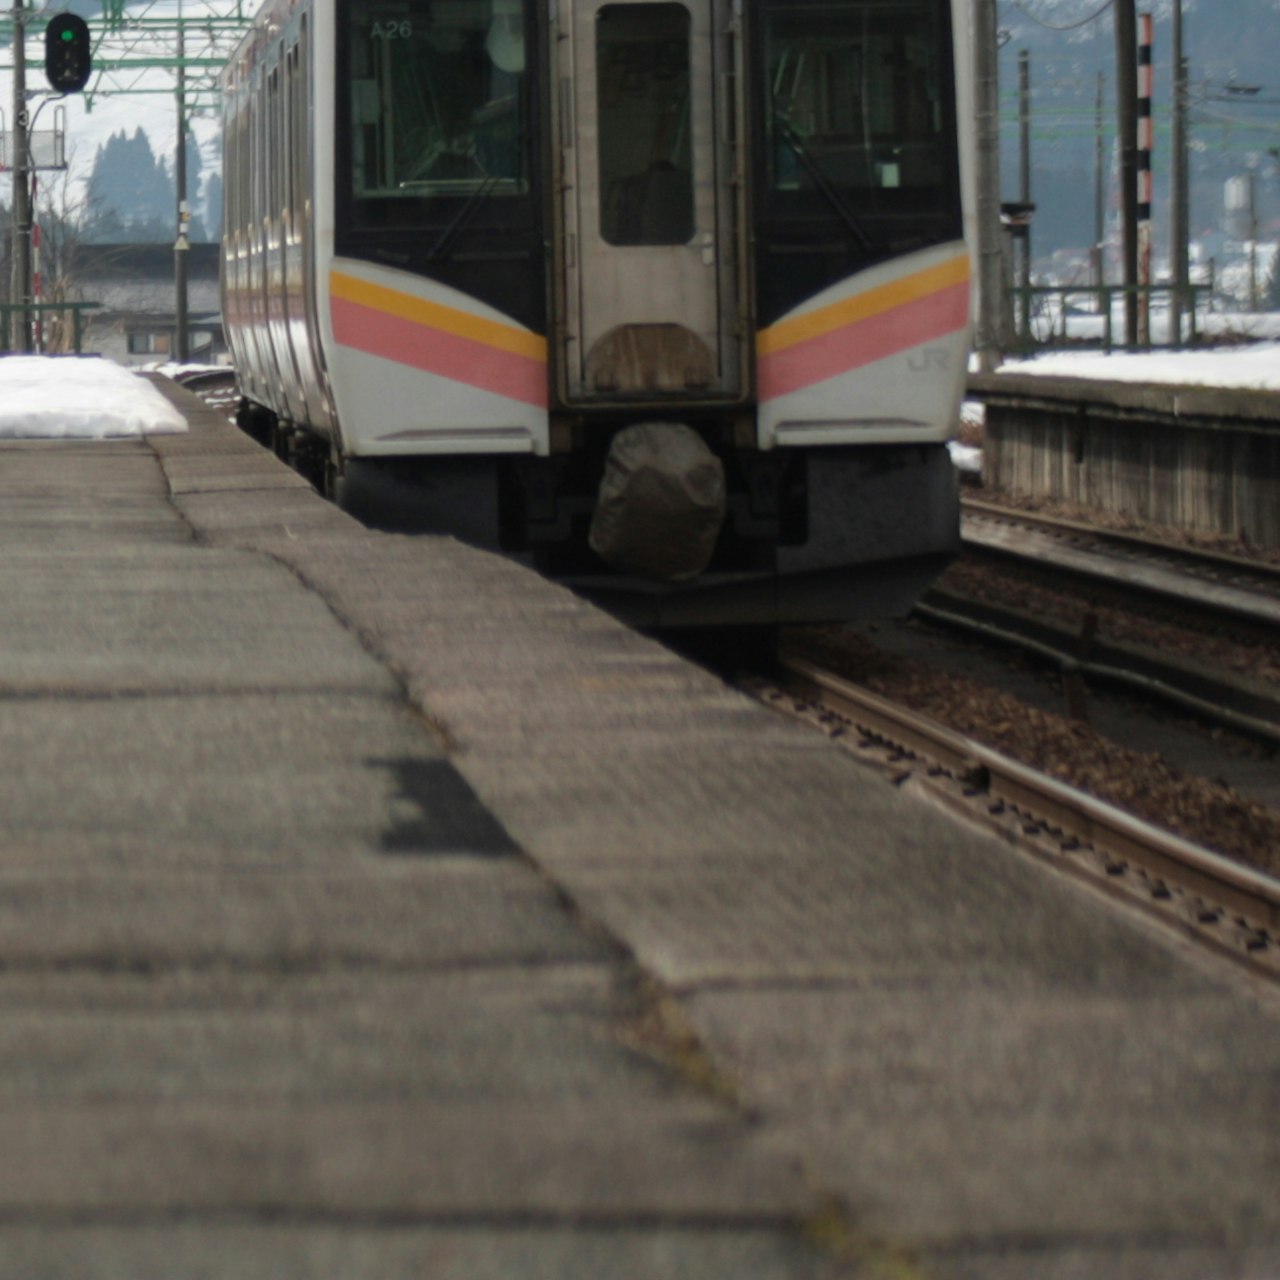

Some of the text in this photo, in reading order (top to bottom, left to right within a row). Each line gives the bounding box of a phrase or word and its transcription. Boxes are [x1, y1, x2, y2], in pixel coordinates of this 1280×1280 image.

[369, 19, 413, 40] A26
[18, 110, 29, 127] 3
[905, 346, 952, 373] JR
